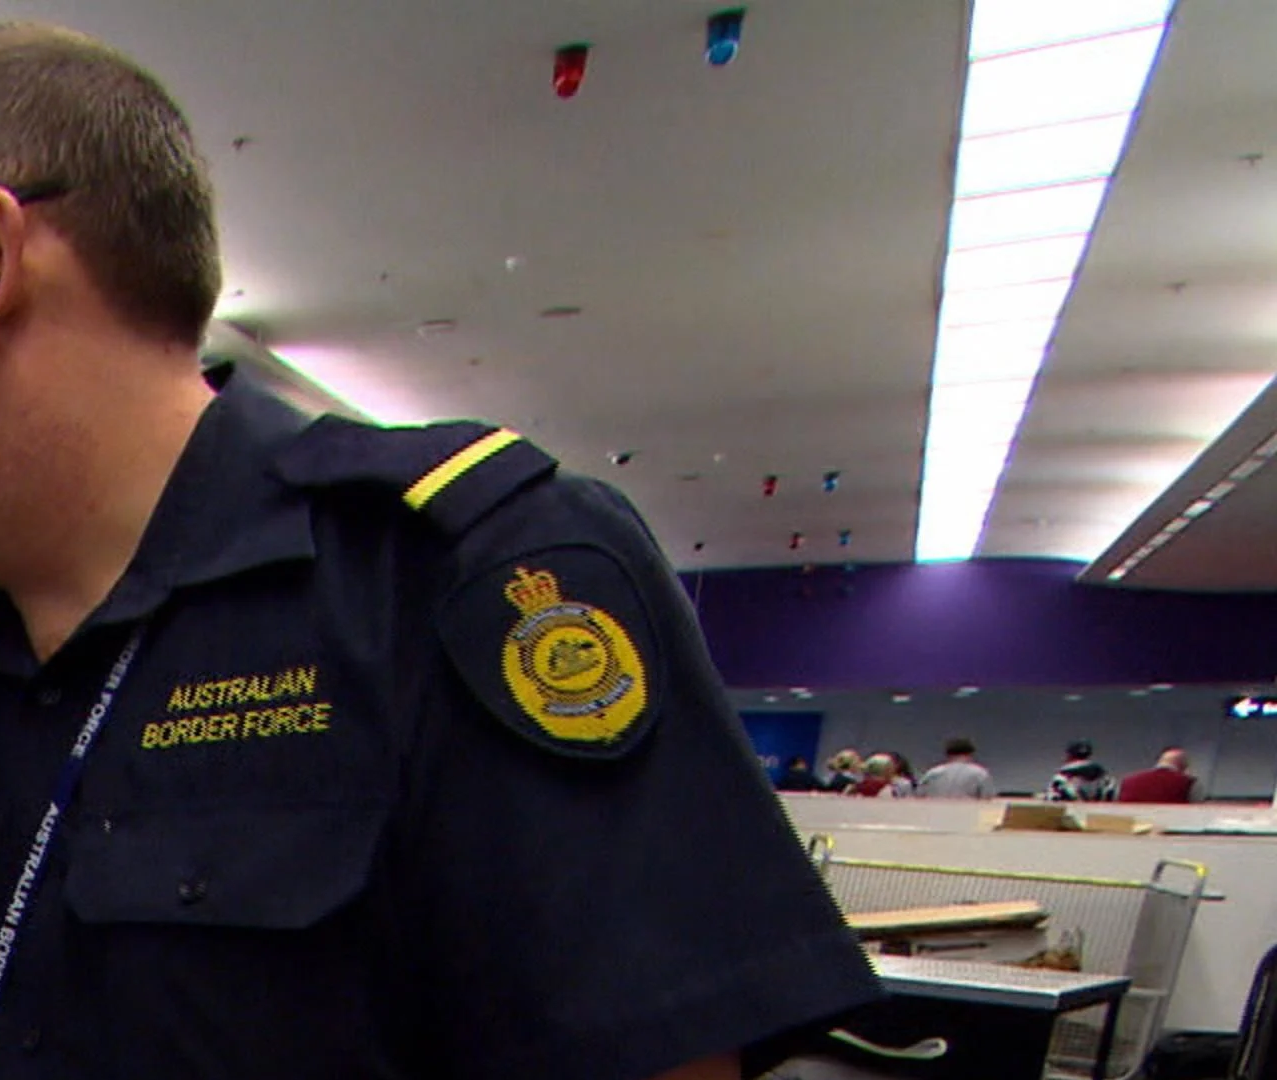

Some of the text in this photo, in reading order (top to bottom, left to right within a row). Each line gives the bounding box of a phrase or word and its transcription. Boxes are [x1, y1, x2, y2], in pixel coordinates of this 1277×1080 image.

[165, 664, 318, 713] AUSTRALIAN
[141, 702, 333, 749] BORDER FORCE
[5, 802, 59, 924] AUSTRALIAN
